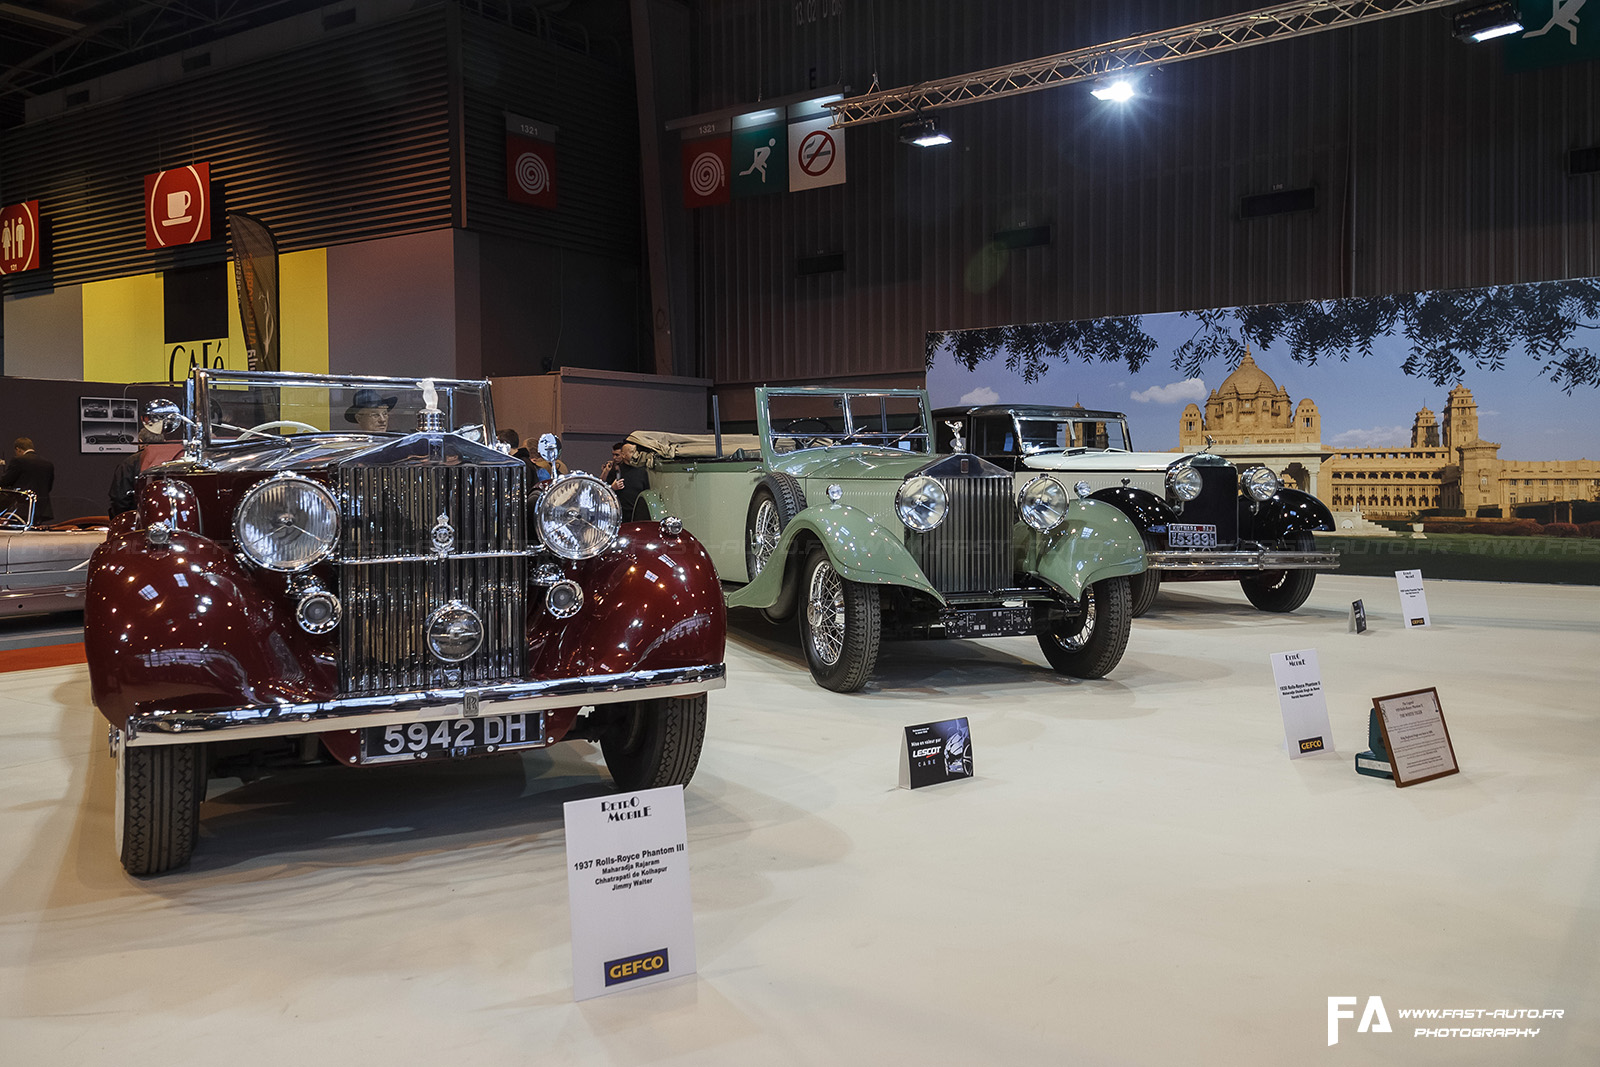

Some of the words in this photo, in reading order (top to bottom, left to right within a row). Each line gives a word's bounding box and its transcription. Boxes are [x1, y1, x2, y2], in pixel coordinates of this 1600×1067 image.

[520, 124, 538, 136] 1321
[698, 124, 716, 134] 1321
[384, 719, 475, 754] 5942
[484, 714, 526, 745] DH
[912, 746, 941, 758] LESCOT
[1301, 740, 1322, 750] GEFCO
[574, 860, 593, 871] 1937
[595, 853, 640, 867] Rolls-Royce
[642, 846, 675, 858] Phantom
[676, 843, 685, 852] III
[602, 863, 634, 874] Maharadja
[635, 859, 660, 869] Rajaram
[595, 873, 631, 885] Chhatrapati
[641, 866, 668, 877] Kolhapur
[612, 882, 632, 891] Jimmy
[634, 878, 653, 887] Walter
[610, 955, 664, 978] GEFCO
